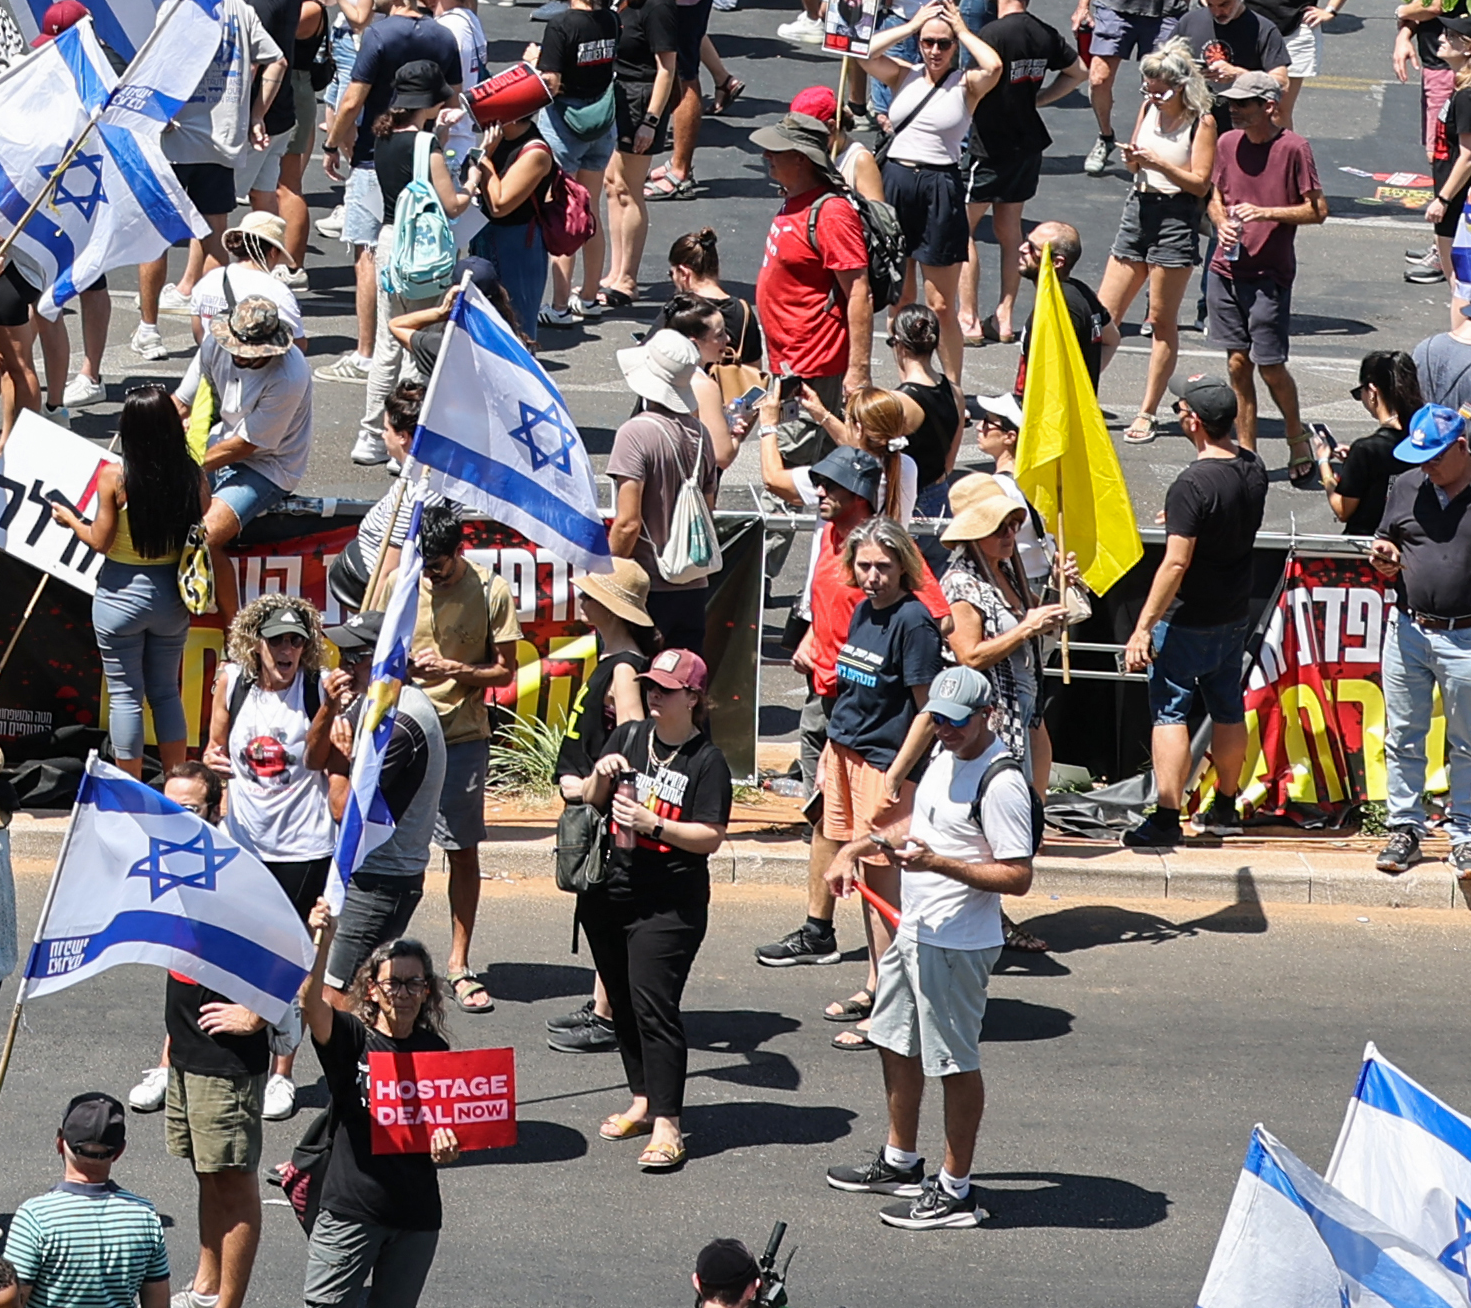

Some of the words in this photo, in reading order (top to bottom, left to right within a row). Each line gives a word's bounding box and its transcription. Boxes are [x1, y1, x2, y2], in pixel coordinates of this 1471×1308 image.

[50, 936, 90, 959] חופשי
[375, 1073, 510, 1101] HOSTAGE
[376, 1103, 454, 1127] DEAL
[456, 1101, 507, 1124] NOW
